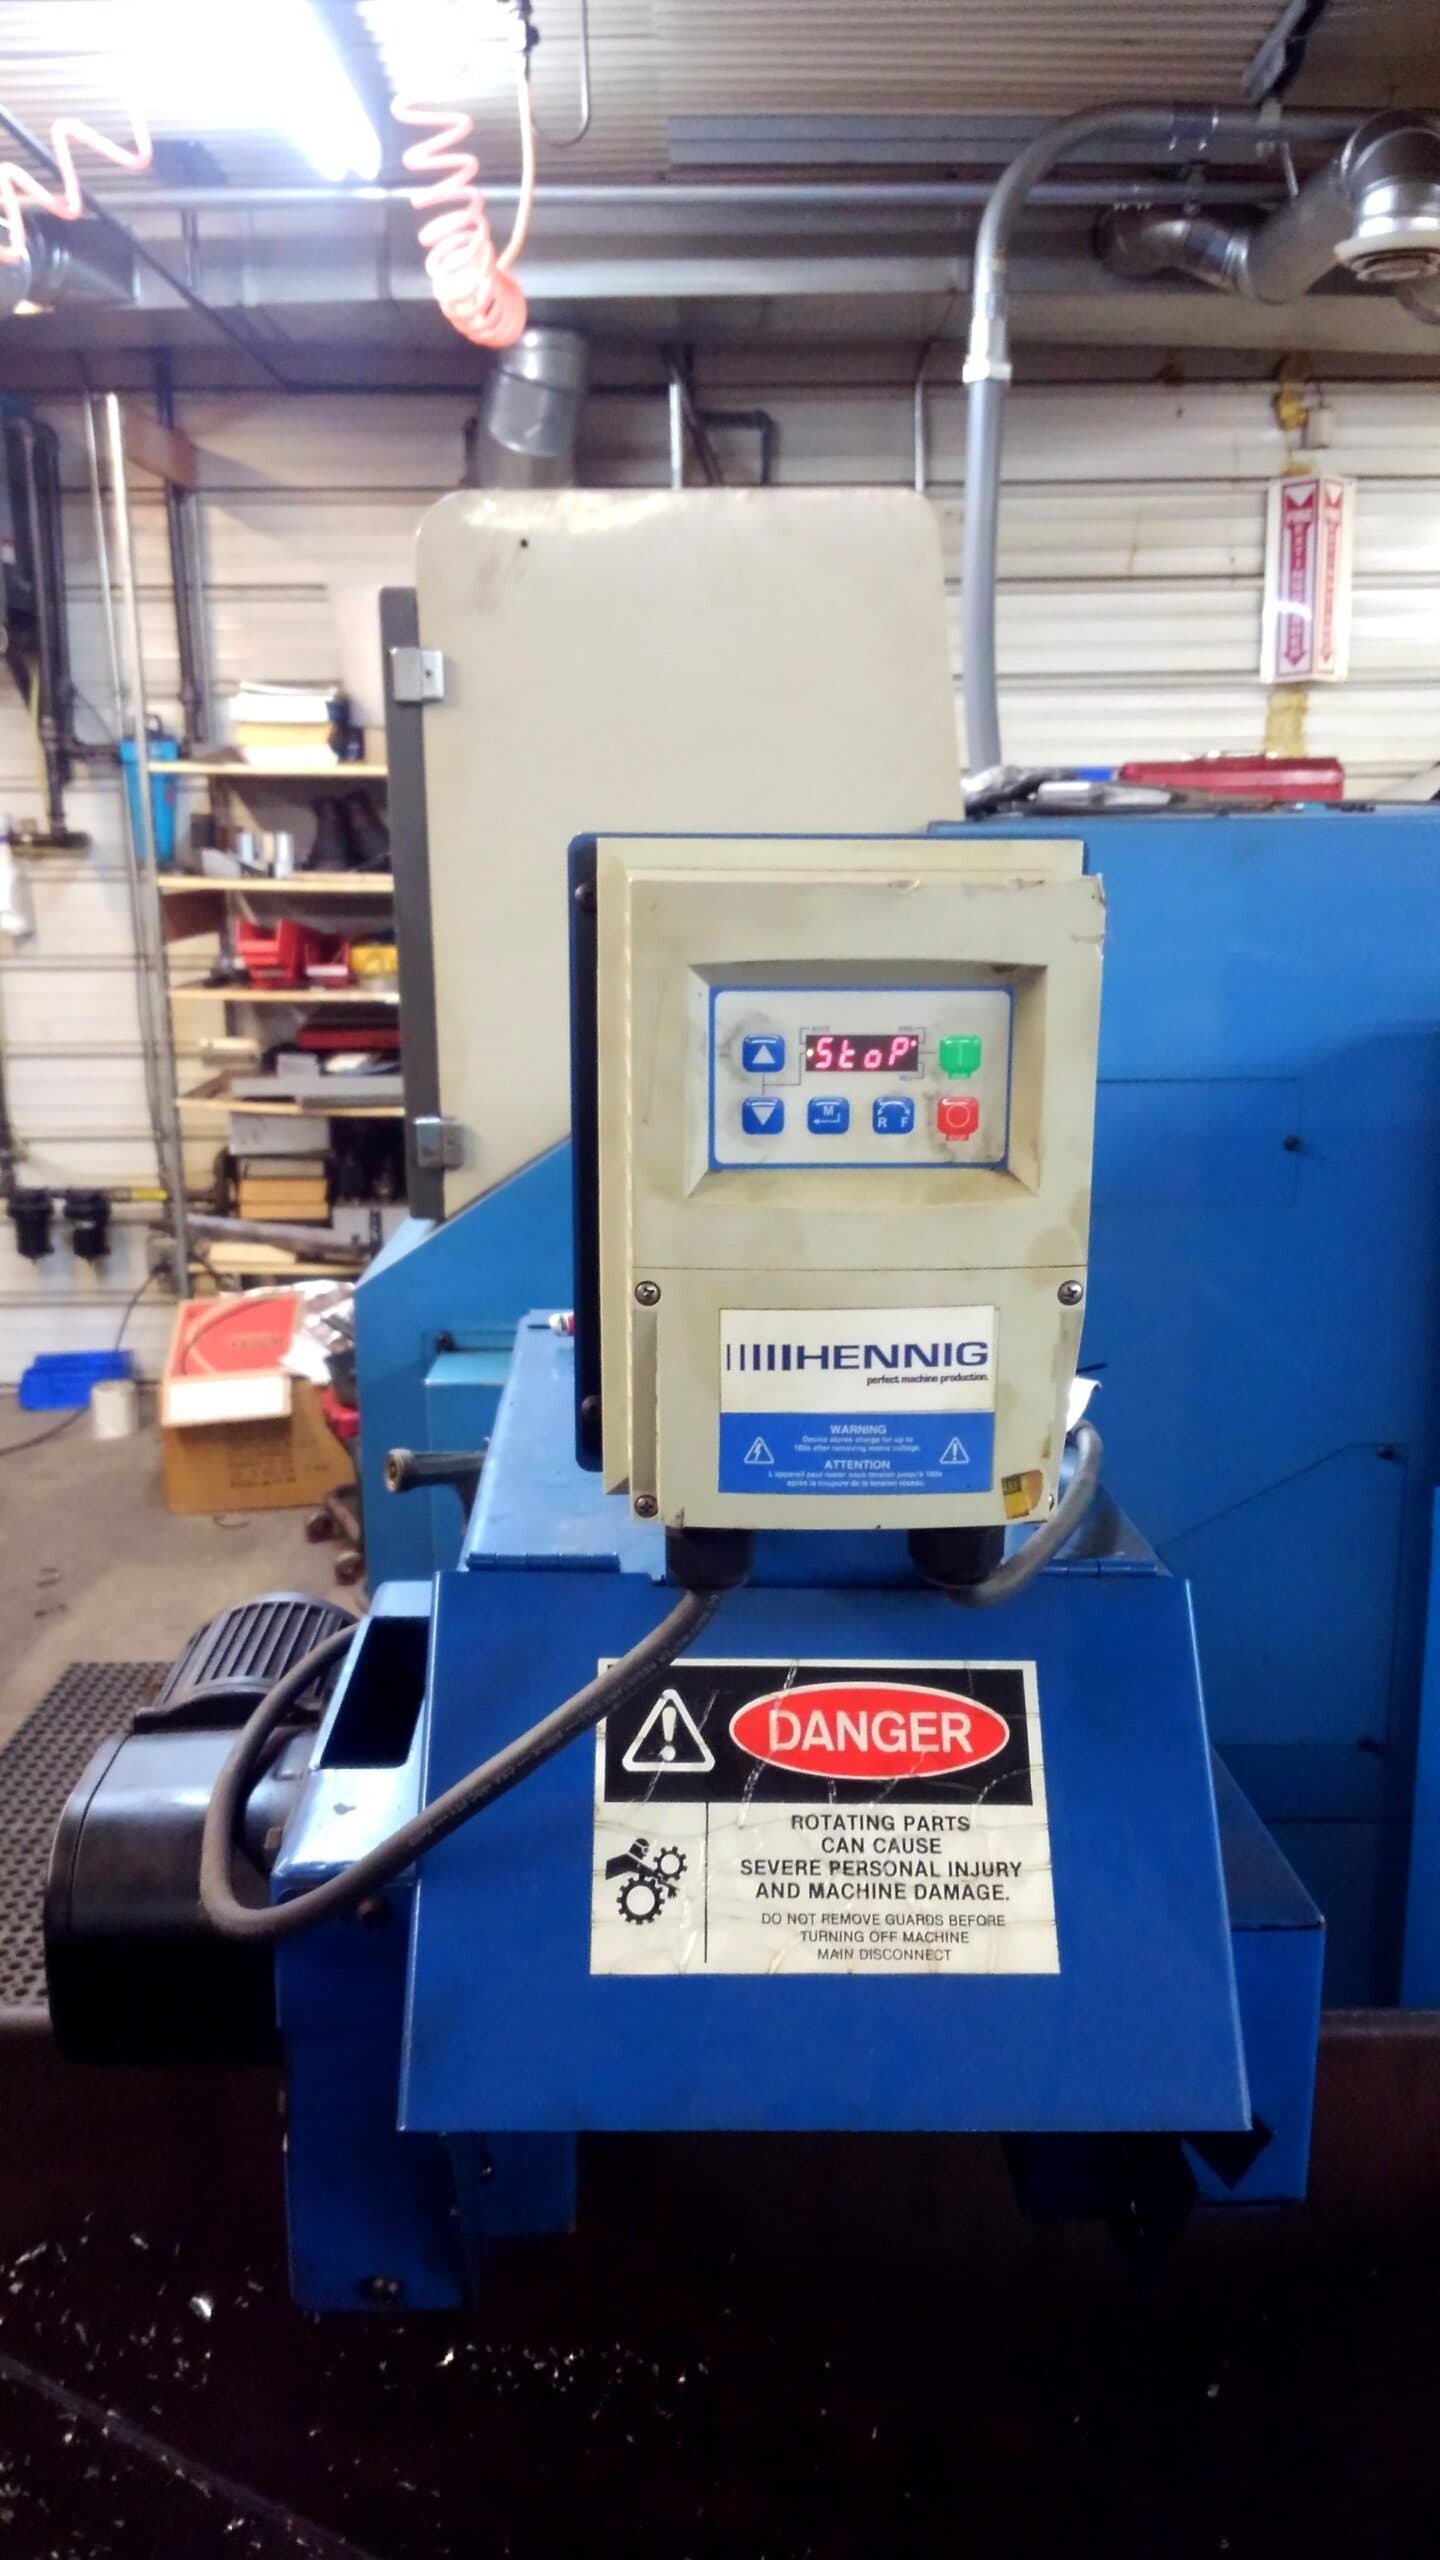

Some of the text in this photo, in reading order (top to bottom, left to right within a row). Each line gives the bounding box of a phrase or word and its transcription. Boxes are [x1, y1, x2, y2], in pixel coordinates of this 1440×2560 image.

[823, 1105, 835, 1117] M
[877, 1116, 909, 1129] R F
[796, 1341, 989, 1370] HENNIG
[866, 1374, 899, 1386] perfect
[901, 1373, 938, 1384] machine
[830, 1424, 887, 1435] WARNING
[824, 1458, 891, 1470] ATTENTION
[770, 1709, 973, 1754] DANGER
[791, 1814, 971, 1832] ROTATING PARTS
[821, 1836, 942, 1854] CAN CAUSE
[740, 1859, 1022, 1878] SEVERE PERSONAL INJURY
[755, 1882, 1009, 1901] AND MACHINE DAMAGE.
[761, 1912, 1006, 1927] DO NOT REMOVE GUARDS BEFORE
[800, 1929, 969, 1944] TURNING OFF MACHINE
[817, 1948, 952, 1961] MAIN DISCONNECT
